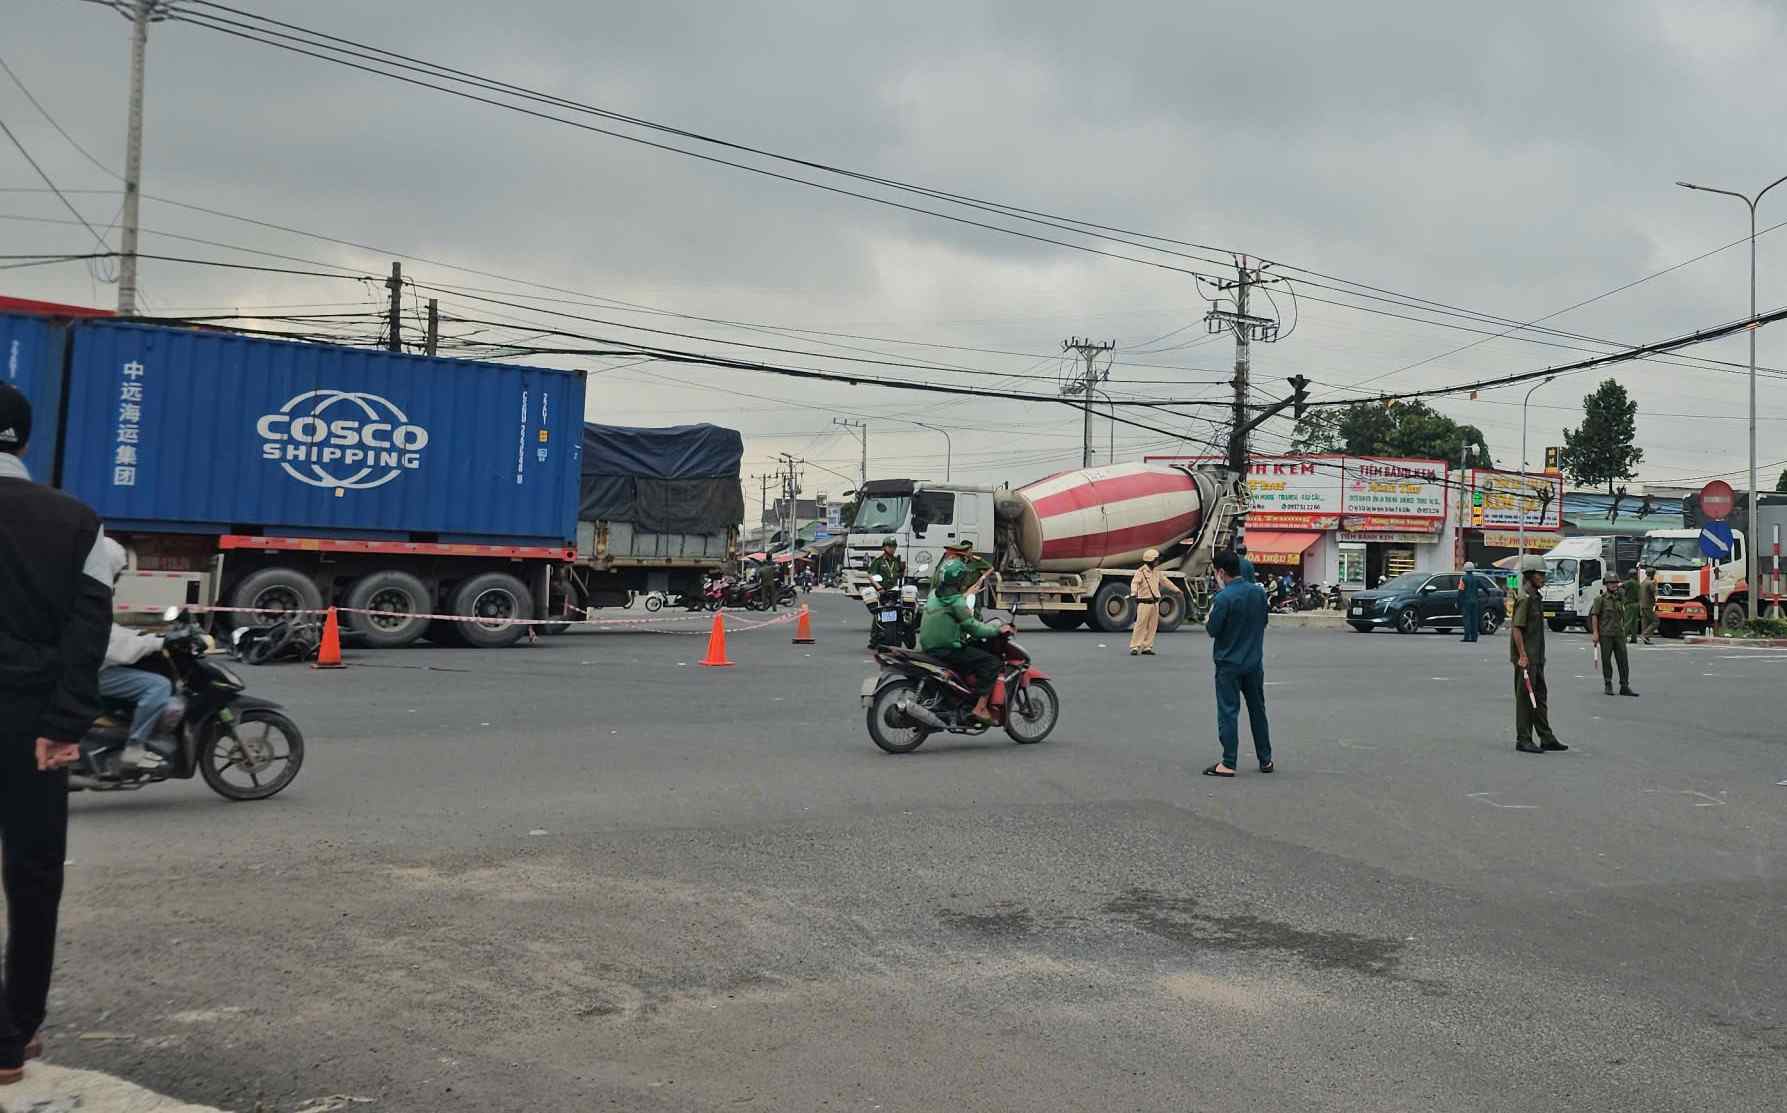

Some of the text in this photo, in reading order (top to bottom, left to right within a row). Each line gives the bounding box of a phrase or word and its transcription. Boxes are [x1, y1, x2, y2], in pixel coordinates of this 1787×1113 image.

[113, 360, 144, 486] 中远海运集团
[257, 414, 429, 451] COSCO
[263, 443, 420, 469] SHIPPING
[1273, 463, 1315, 475] KEM
